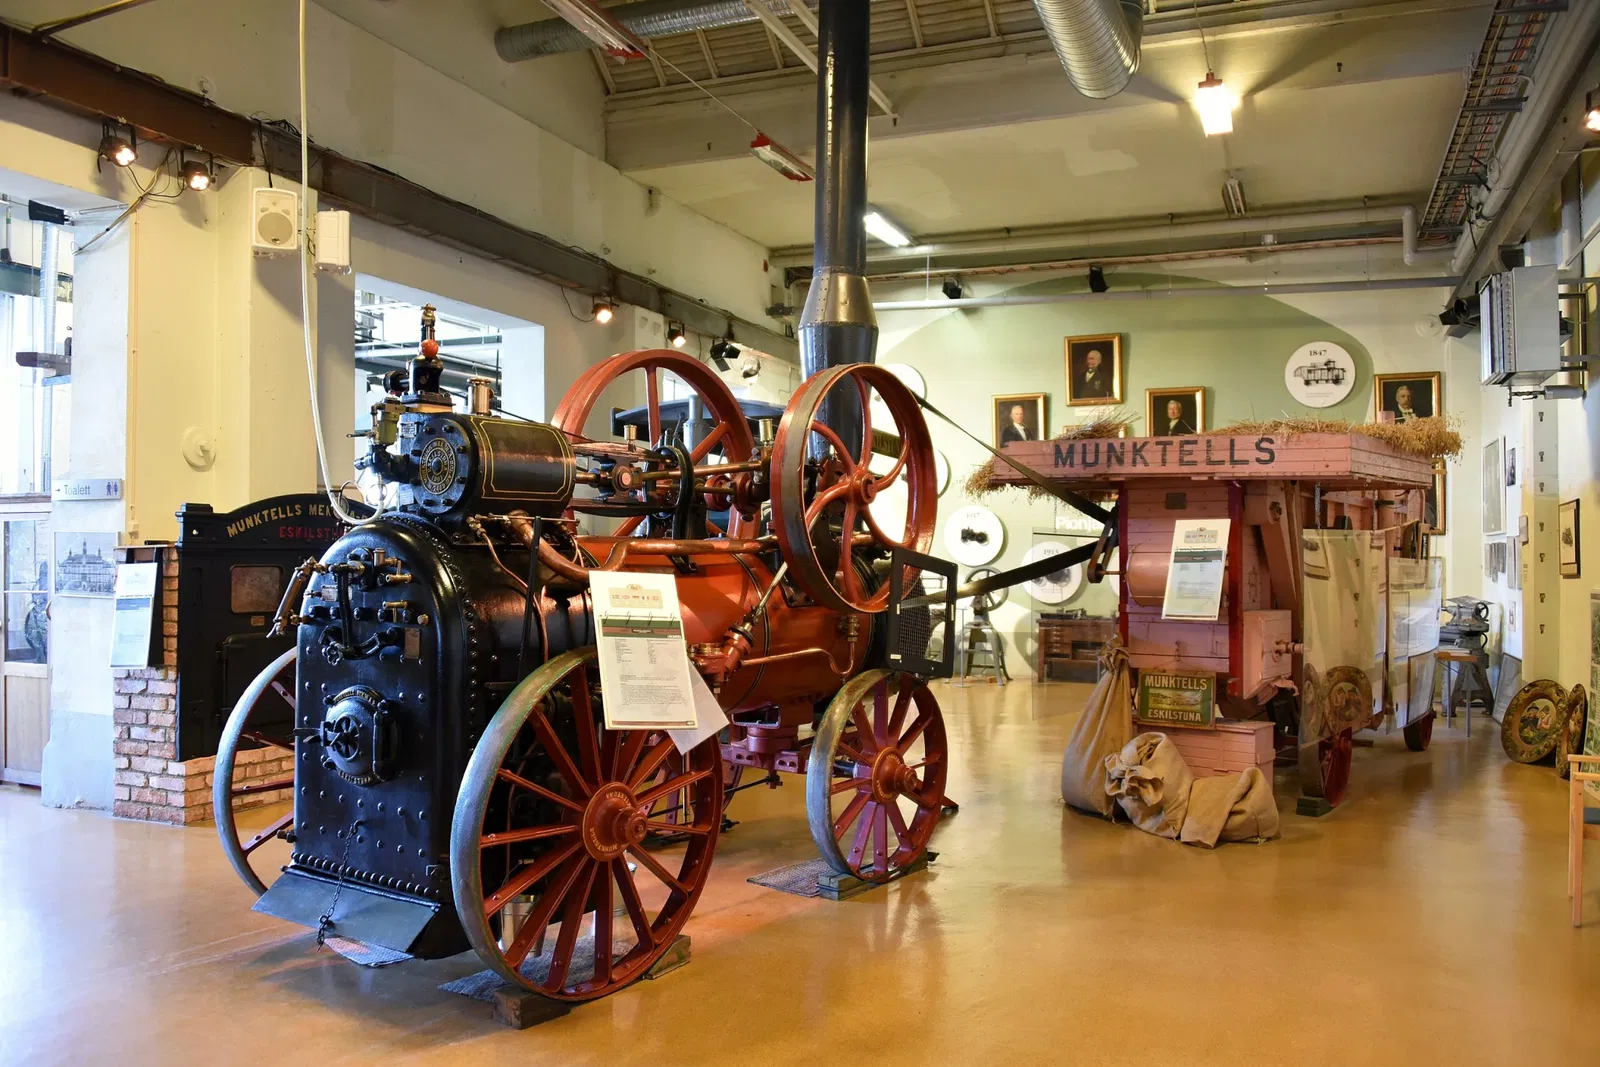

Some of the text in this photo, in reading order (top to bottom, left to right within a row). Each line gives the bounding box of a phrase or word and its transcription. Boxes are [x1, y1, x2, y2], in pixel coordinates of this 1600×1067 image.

[1054, 437, 1276, 468] MUNKTELLS
[64, 484, 90, 495] Toalett
[226, 504, 302, 538] MUNKTELLS
[1145, 675, 1208, 690] MUNKTELLS
[1148, 709, 1202, 722] ESKILSTUNA
